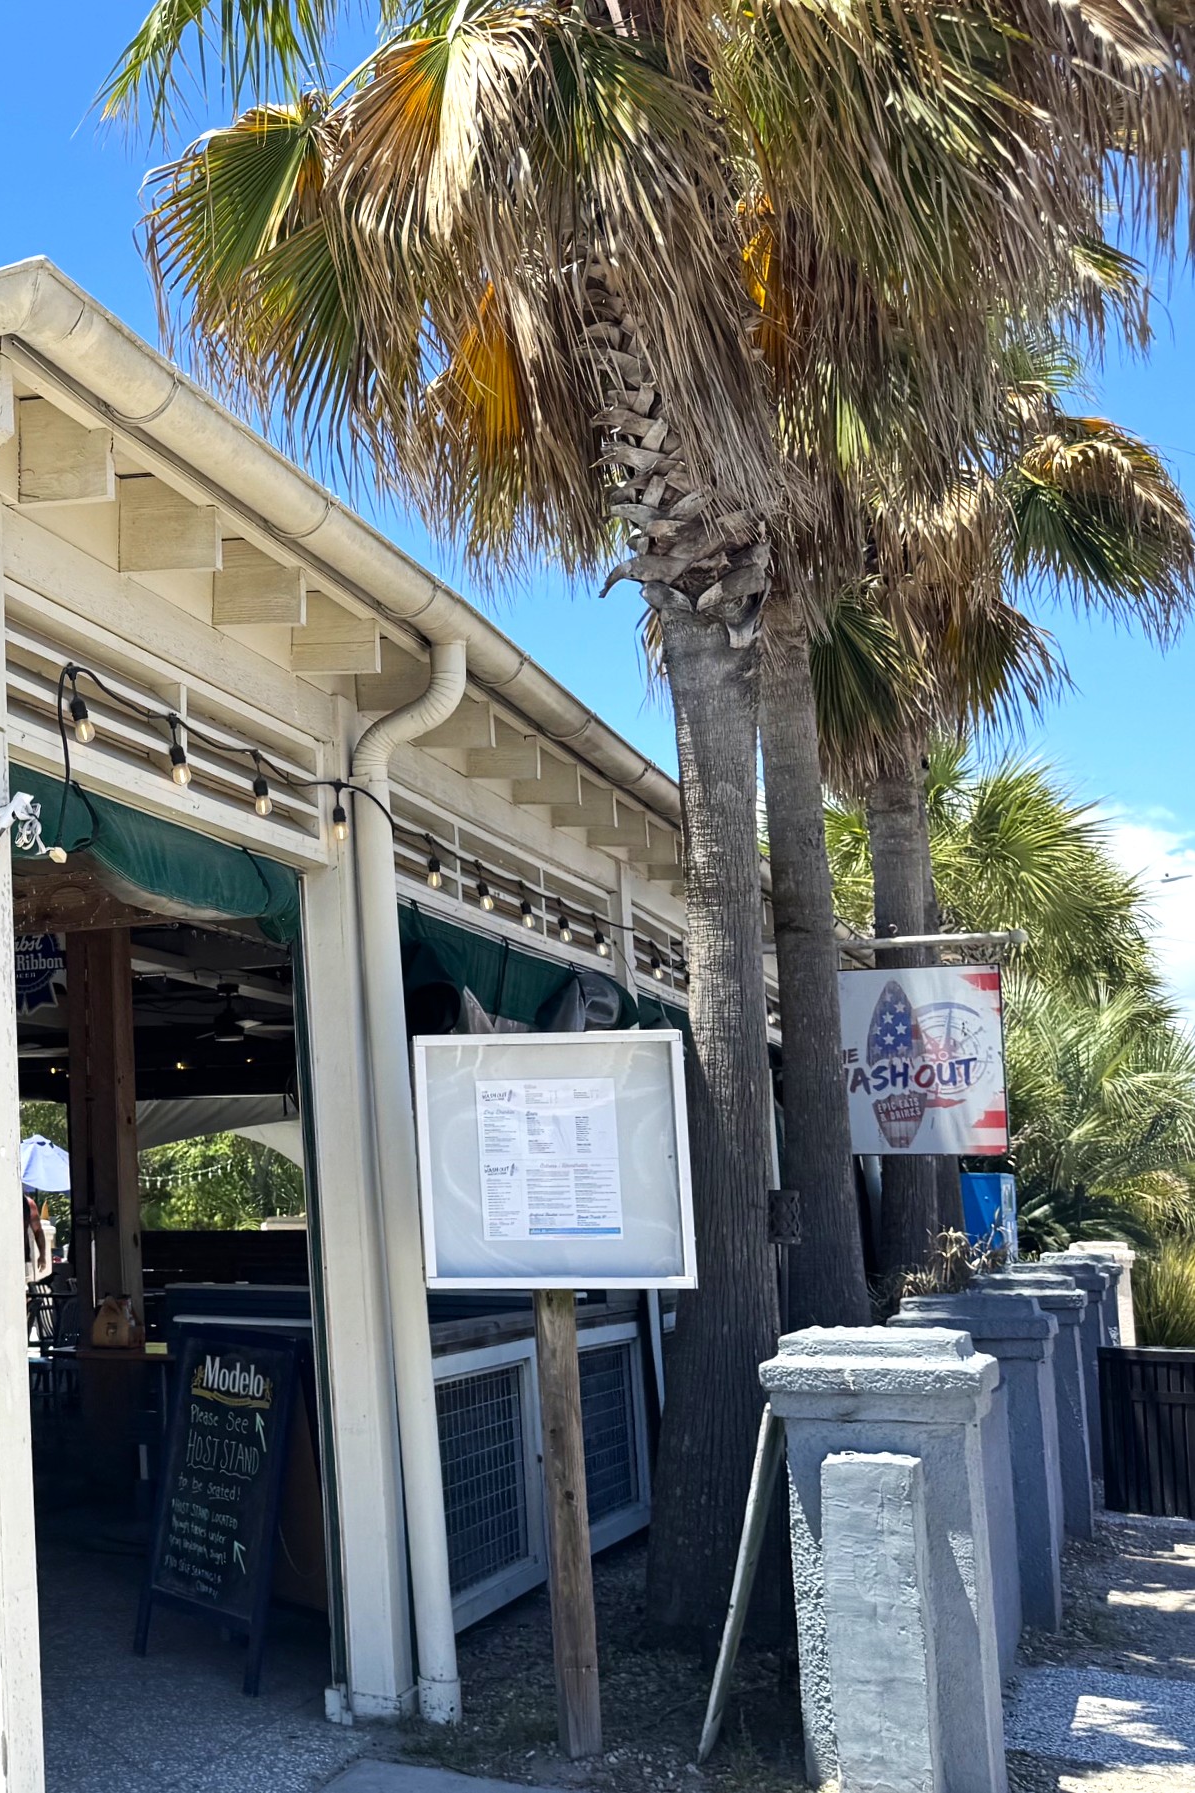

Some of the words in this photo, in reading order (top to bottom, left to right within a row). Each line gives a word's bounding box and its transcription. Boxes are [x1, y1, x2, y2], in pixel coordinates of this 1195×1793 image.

[15, 952, 65, 972] Ribbon
[877, 1103, 896, 1115] EPIC
[899, 1097, 920, 1109] EATS
[889, 1107, 922, 1120] DRINKS
[203, 1354, 264, 1398] Modelo
[190, 1403, 218, 1426] Please
[226, 1411, 249, 1434] See
[186, 1428, 220, 1466] HOST
[220, 1439, 260, 1475] STAND
[192, 1476, 203, 1491] be
[211, 1511, 239, 1531] LOCATED
